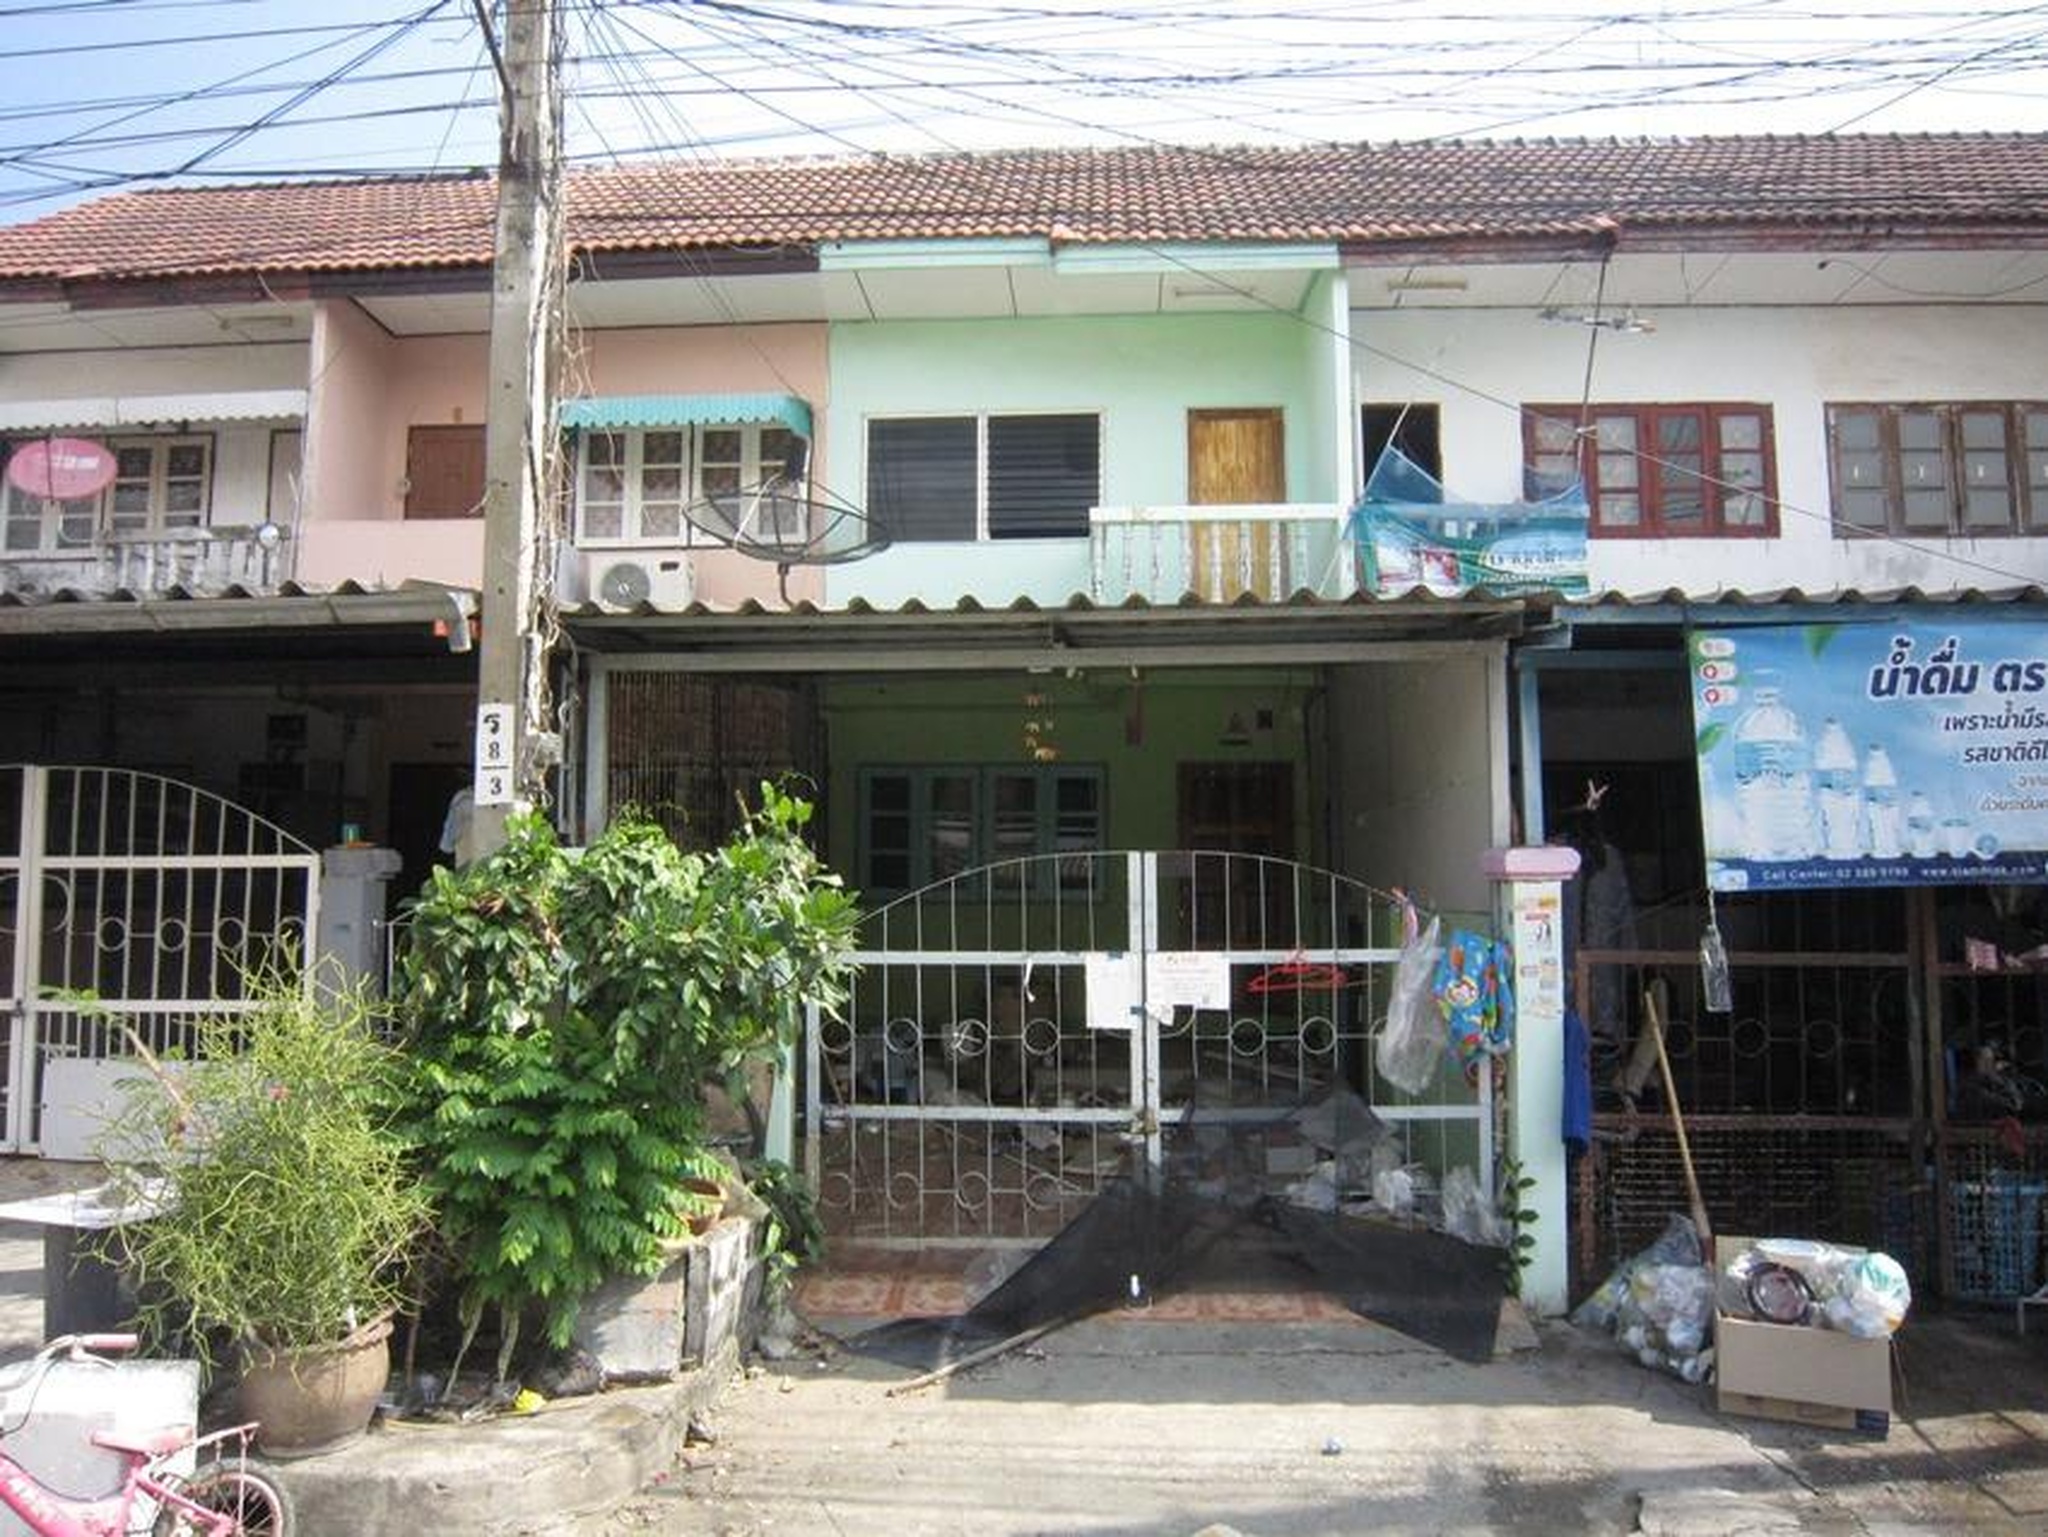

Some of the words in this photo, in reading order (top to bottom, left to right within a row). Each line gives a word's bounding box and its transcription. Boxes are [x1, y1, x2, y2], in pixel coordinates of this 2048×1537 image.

[1870, 637, 1979, 697] น้ำดื่ม
[1945, 701, 2048, 731] เพราะน้ำมีร
[488, 741, 501, 760] 8
[490, 776, 503, 796] 3
